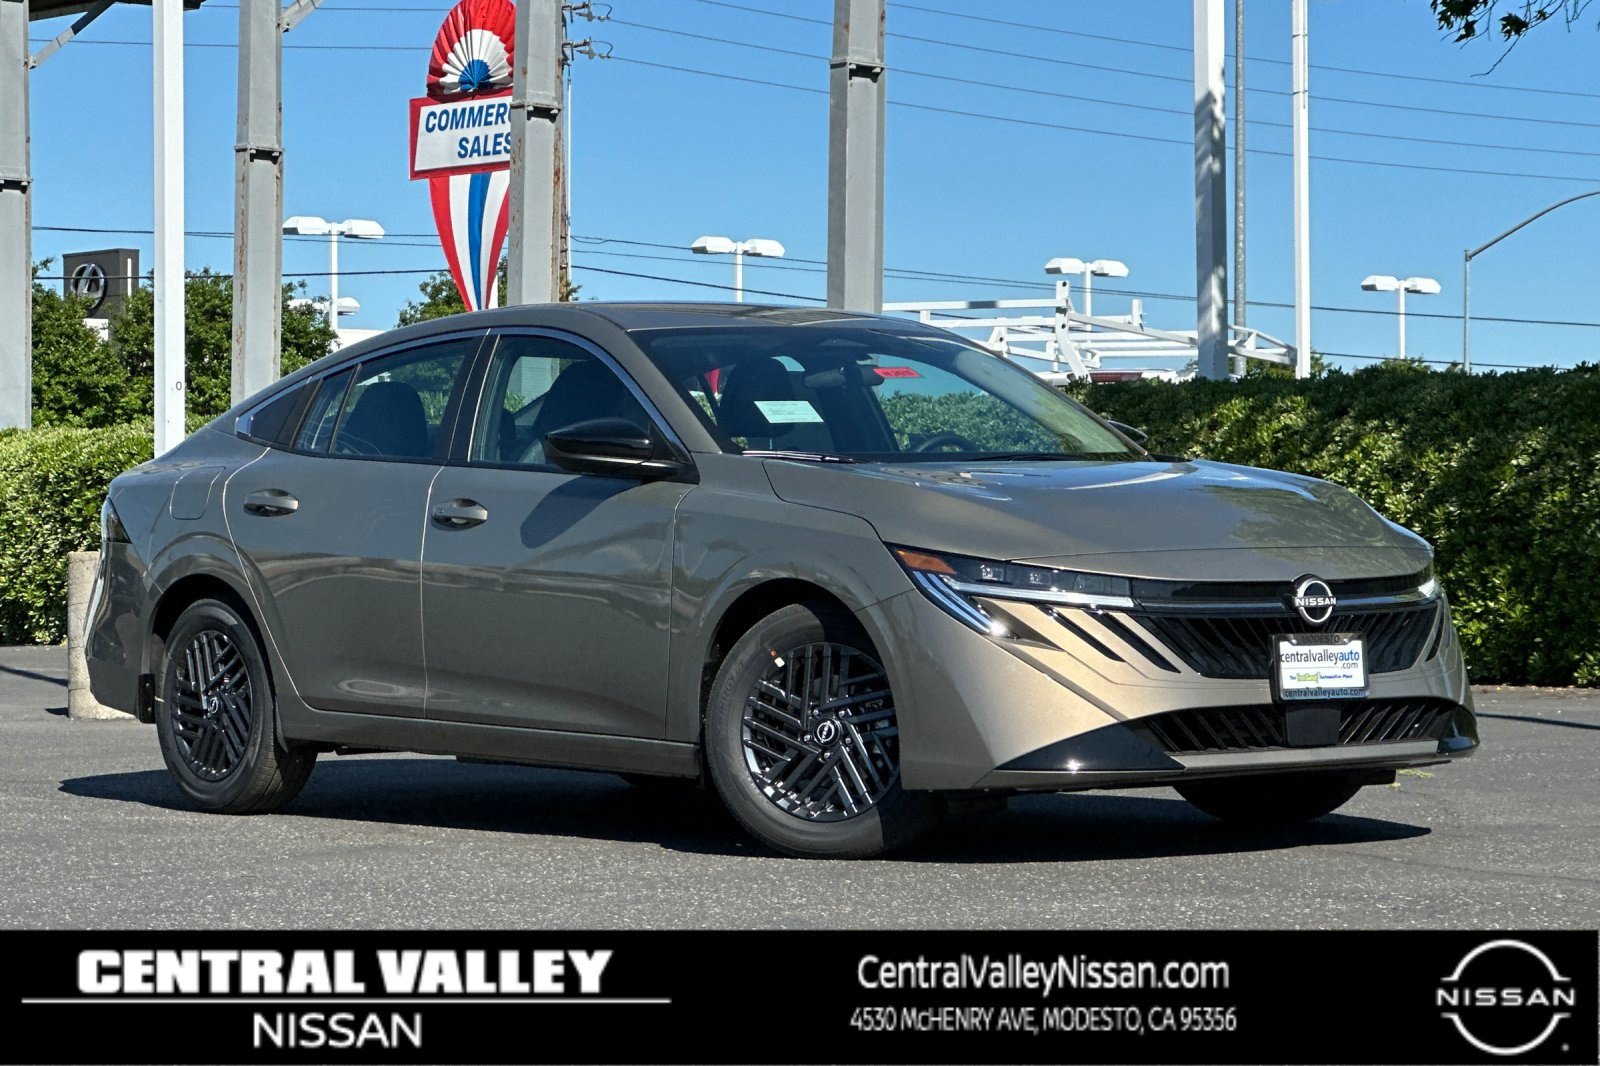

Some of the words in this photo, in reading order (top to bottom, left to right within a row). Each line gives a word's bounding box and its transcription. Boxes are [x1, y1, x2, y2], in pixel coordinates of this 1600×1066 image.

[425, 103, 511, 133] COMMER
[457, 132, 511, 159] SALES
[1295, 597, 1337, 606] NISSAN
[1280, 649, 1360, 665] centralvalleyauto
[1285, 687, 1365, 697] centralvalleyauto.com
